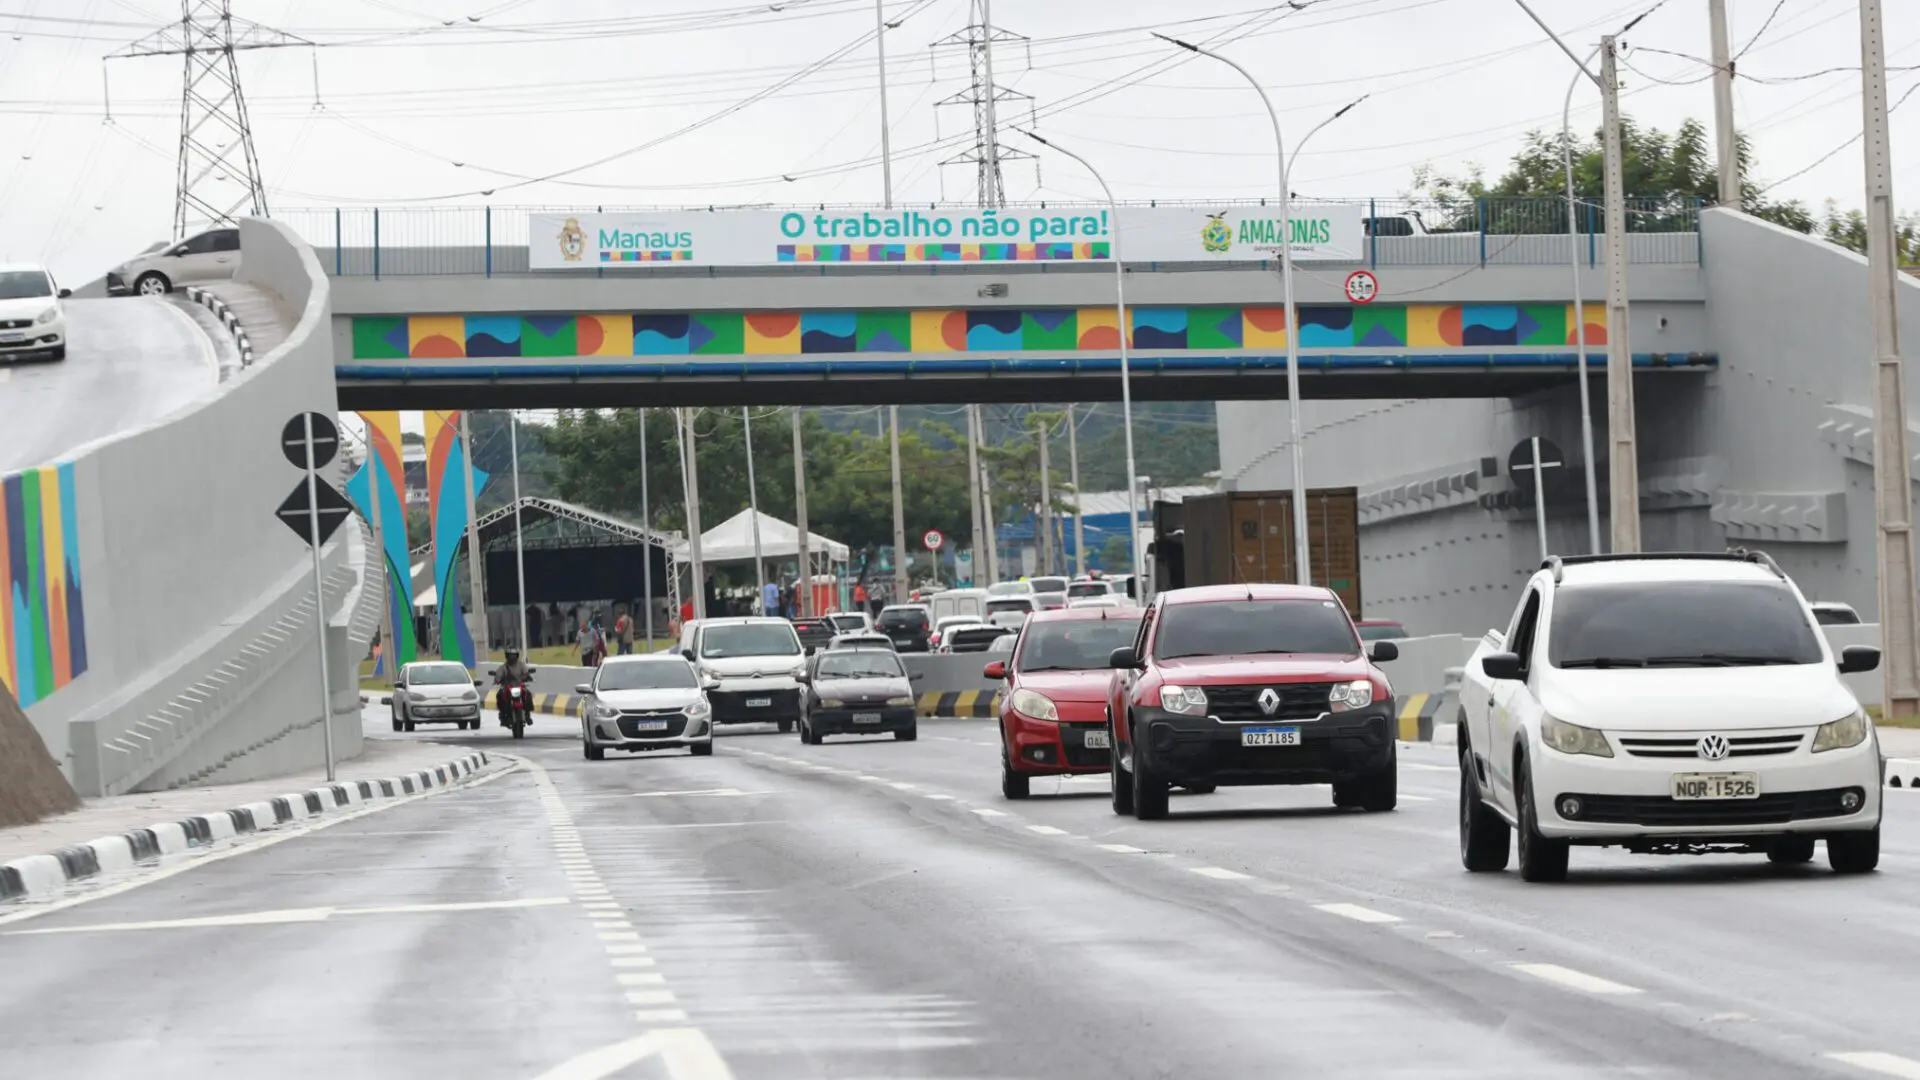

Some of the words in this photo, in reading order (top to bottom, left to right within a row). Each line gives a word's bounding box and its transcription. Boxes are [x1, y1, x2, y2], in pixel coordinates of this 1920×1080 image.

[780, 212, 806, 238] O
[813, 211, 953, 238] trabalho
[961, 210, 1020, 237] não
[1029, 210, 1109, 242] para!
[599, 228, 693, 249] Manaus
[927, 533, 939, 544] 60
[1246, 732, 1295, 745] QZT1185
